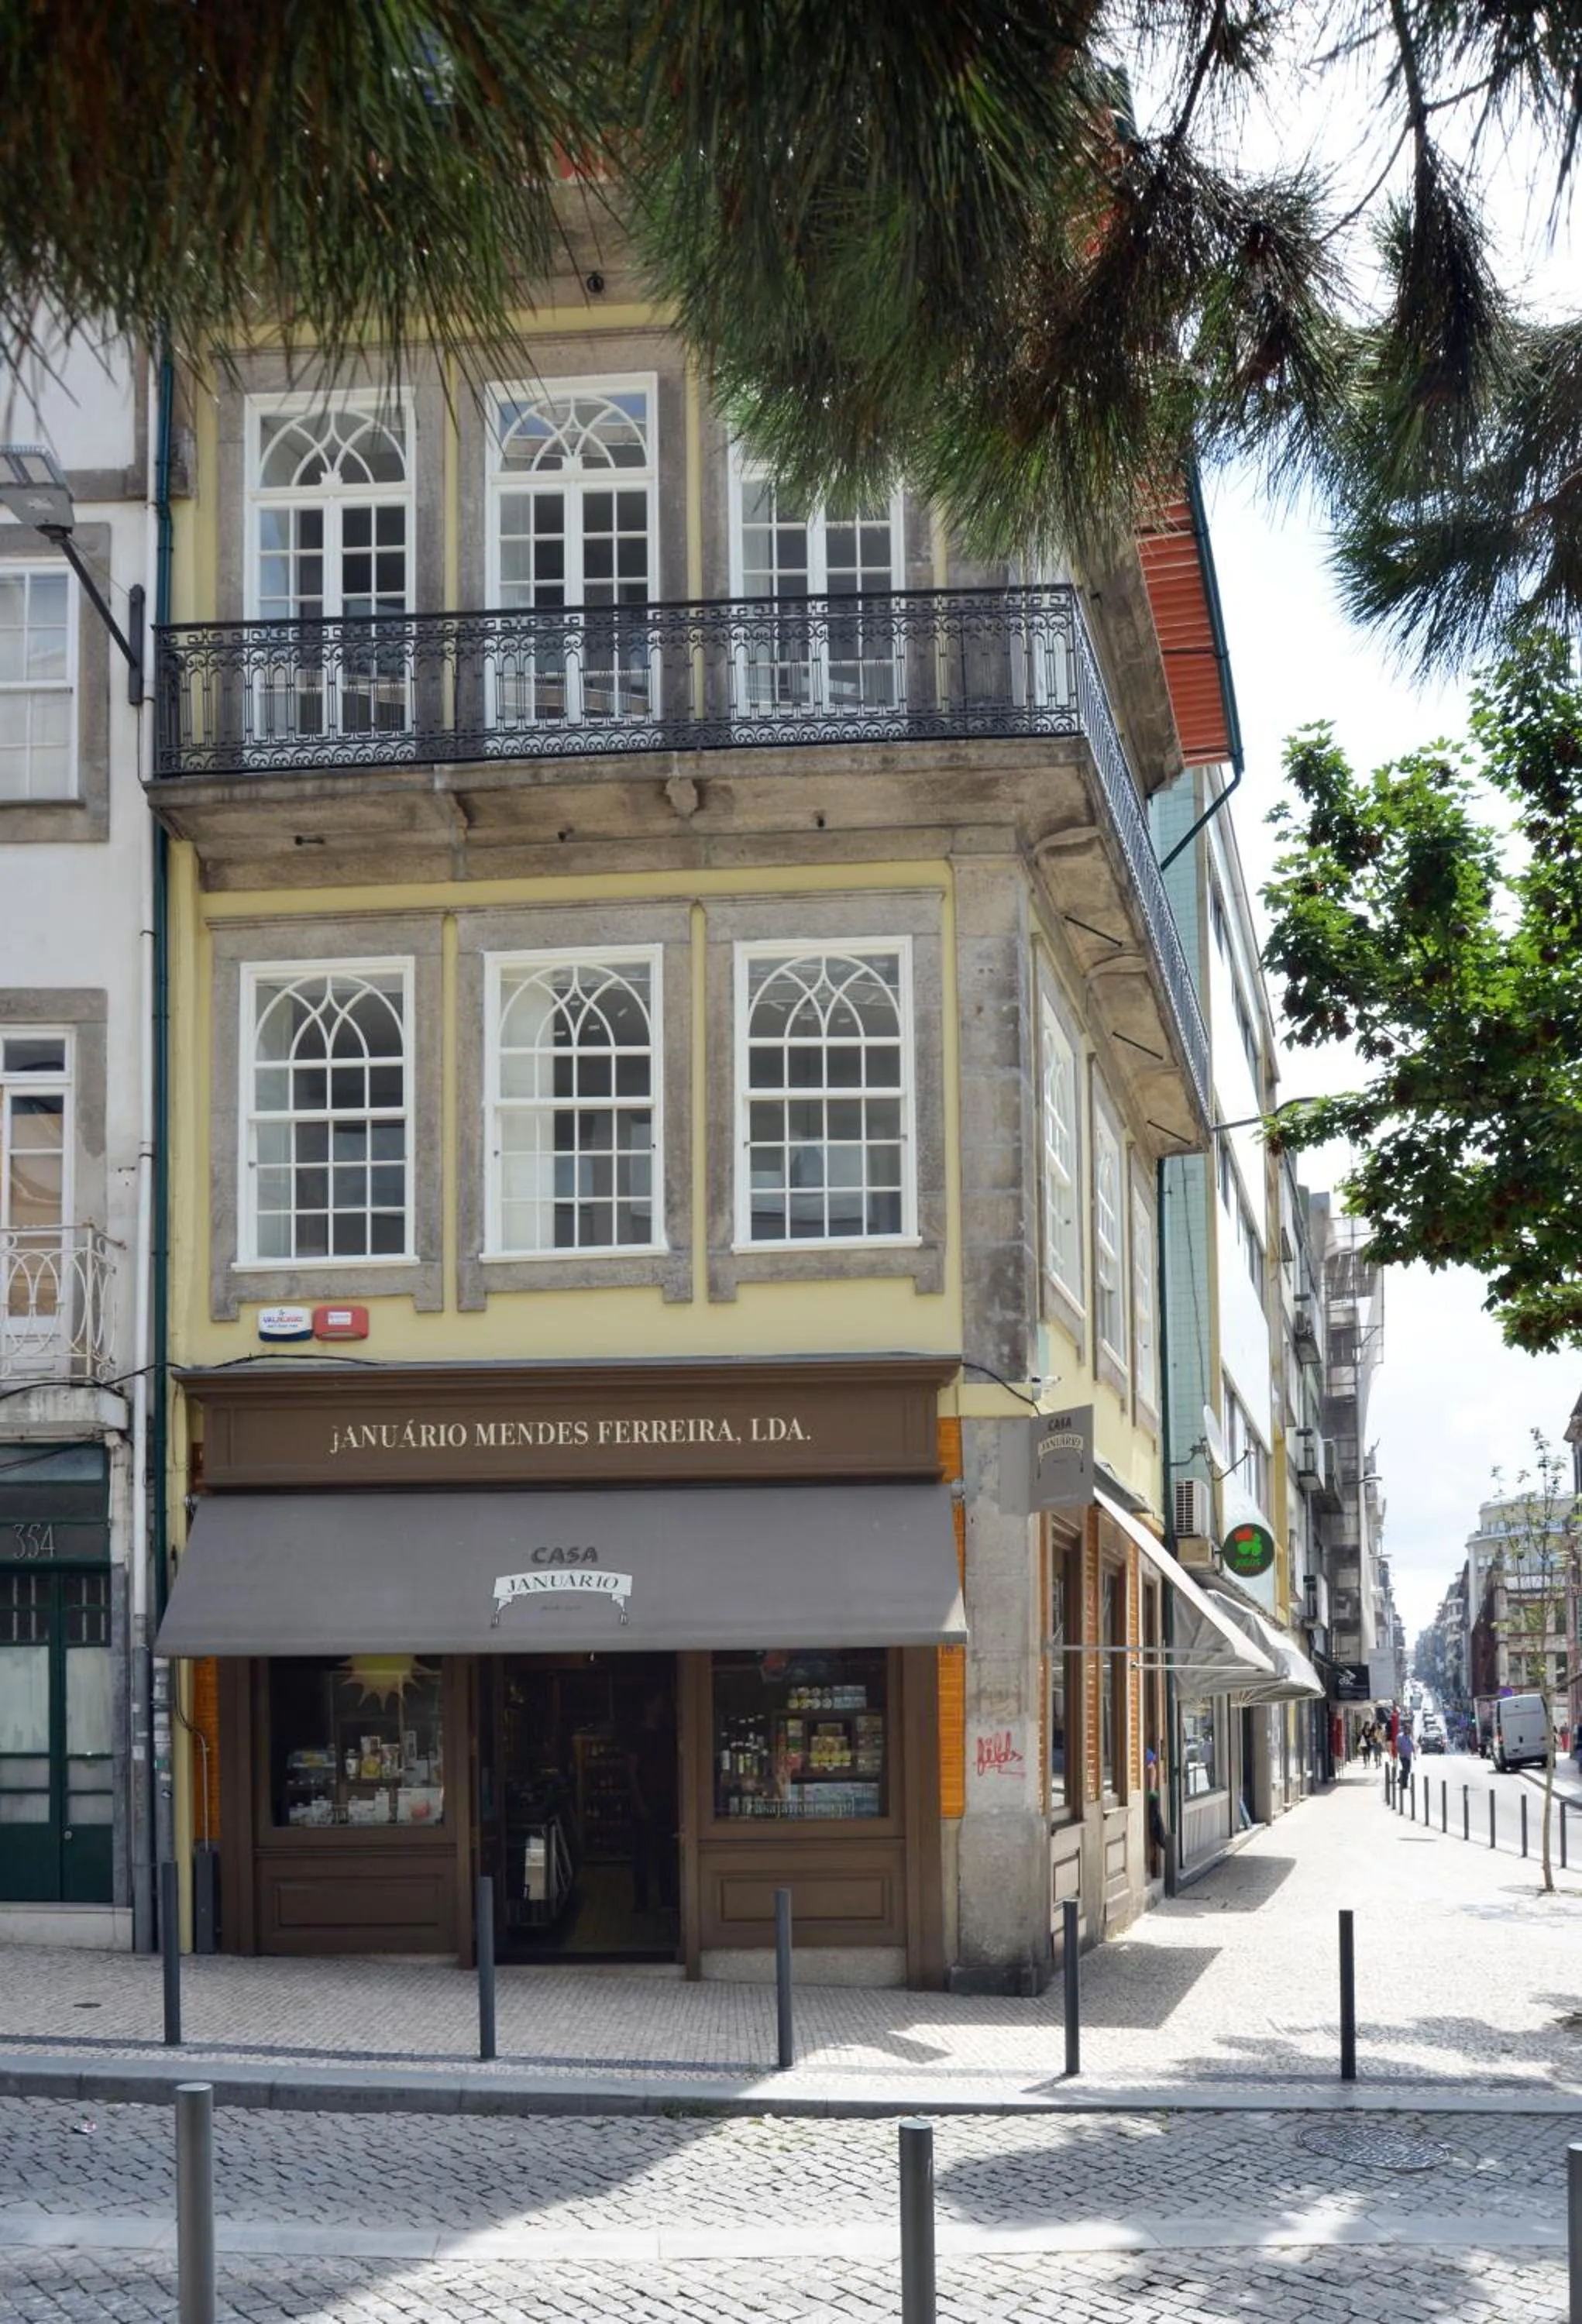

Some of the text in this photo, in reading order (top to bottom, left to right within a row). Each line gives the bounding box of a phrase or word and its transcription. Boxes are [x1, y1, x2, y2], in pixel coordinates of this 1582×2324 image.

[329, 1417, 811, 1454] JANUÁRIO MENDES FERREIRA, LDA.
[12, 1524, 55, 1559] 354
[531, 1547, 598, 1564] CASA
